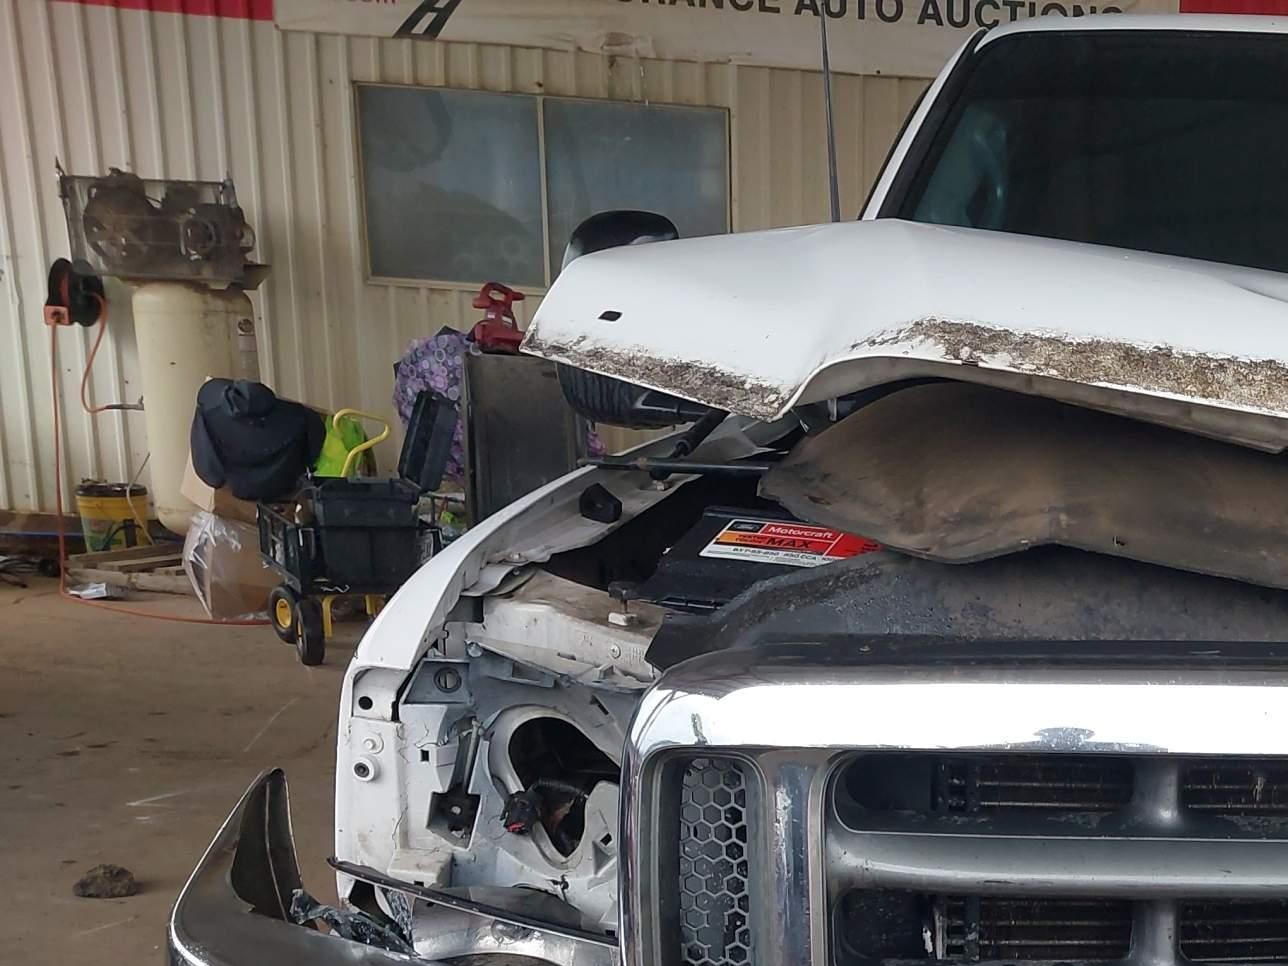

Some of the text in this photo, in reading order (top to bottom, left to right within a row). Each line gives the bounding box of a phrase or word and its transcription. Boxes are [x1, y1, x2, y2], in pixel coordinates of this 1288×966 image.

[794, 0, 904, 23] AUTO
[916, 0, 1123, 28] AUCTI
[767, 526, 834, 539] Motorcraft
[767, 538, 812, 549] MAX
